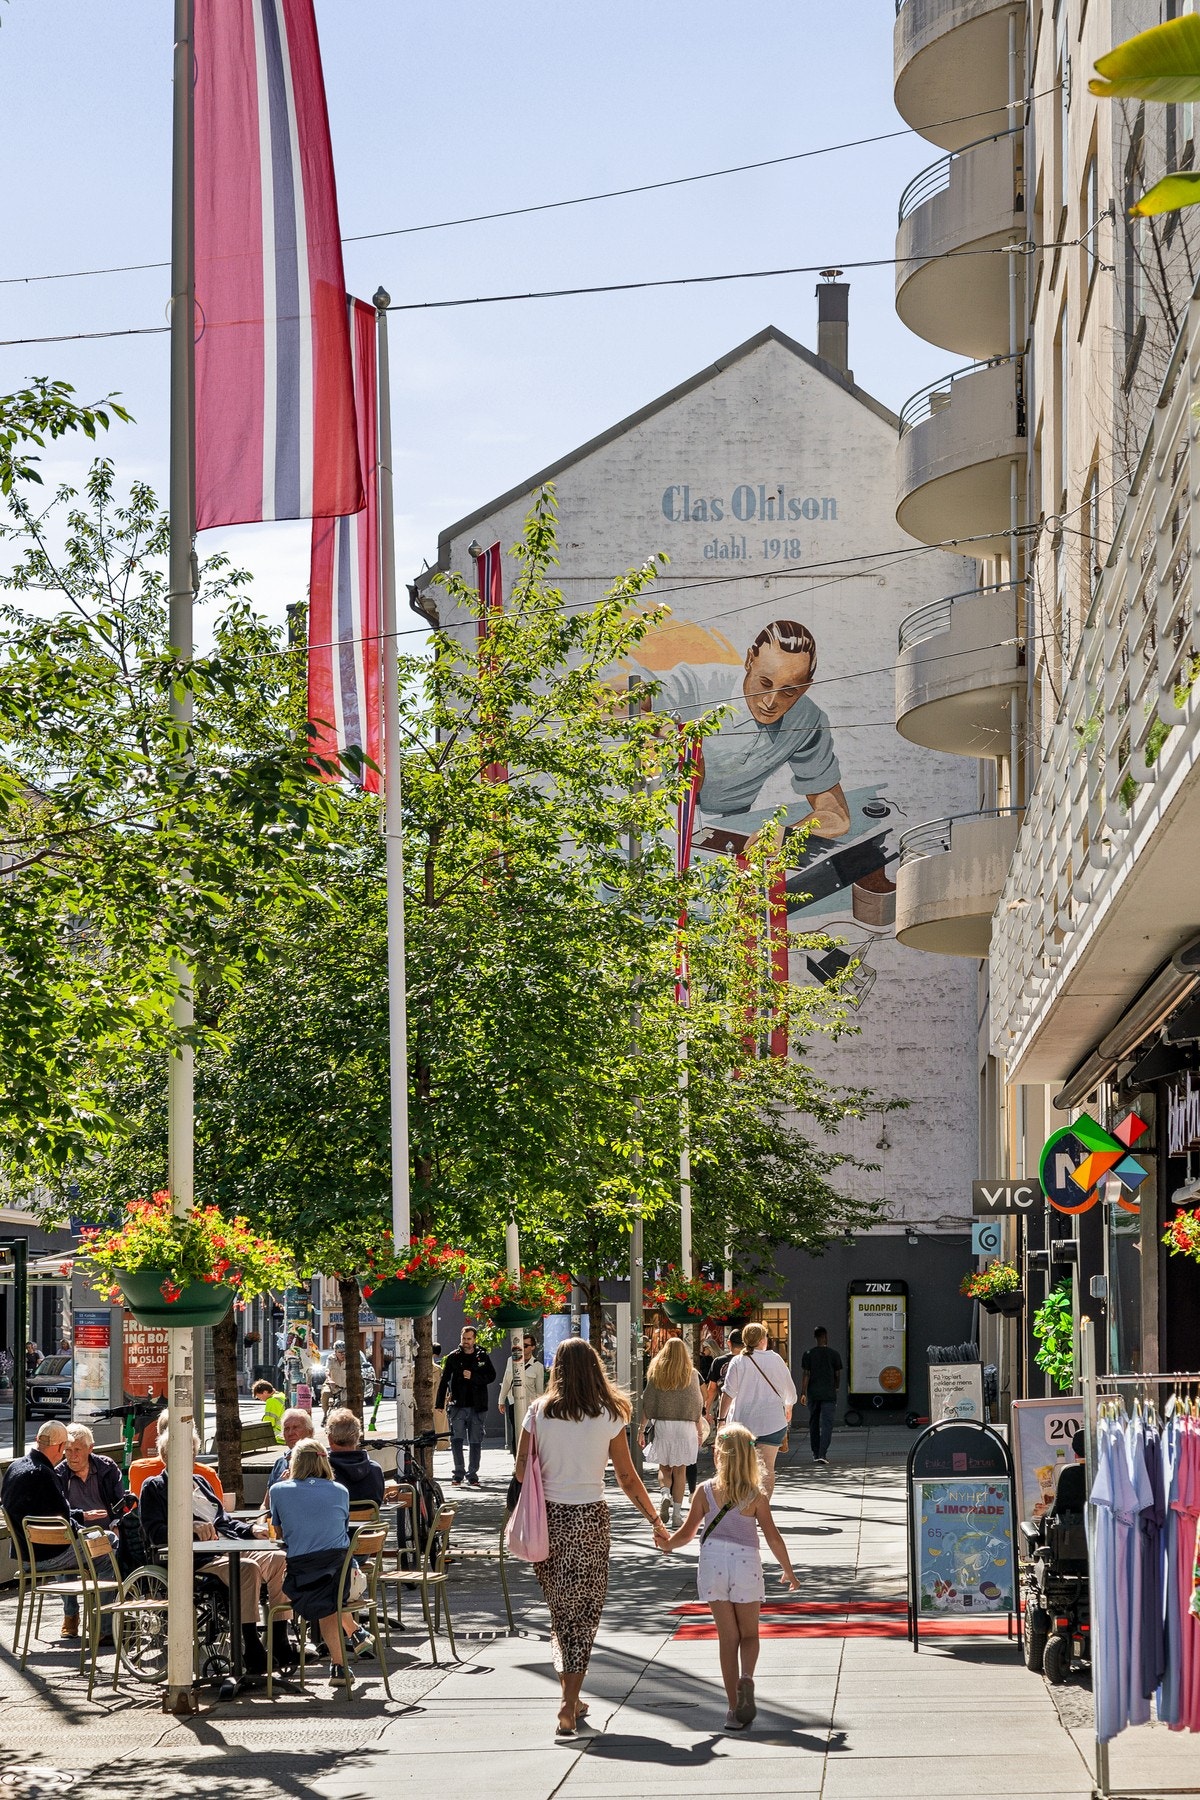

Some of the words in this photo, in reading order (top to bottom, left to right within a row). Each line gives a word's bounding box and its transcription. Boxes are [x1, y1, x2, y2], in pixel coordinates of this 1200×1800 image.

[662, 484, 724, 522] Clas
[731, 484, 838, 522] Ohlson
[703, 535, 752, 560] etabl.
[762, 538, 801, 560] 1918
[980, 1187, 1034, 1208] VIC
[858, 1303, 898, 1311] BUNNPRIS
[123, 1333, 145, 1344] ING
[128, 1346, 155, 1355] RIGHT
[139, 1355, 166, 1364] OSLO!
[949, 1491, 988, 1502] NYHET
[935, 1504, 1004, 1515] LIMONADE
